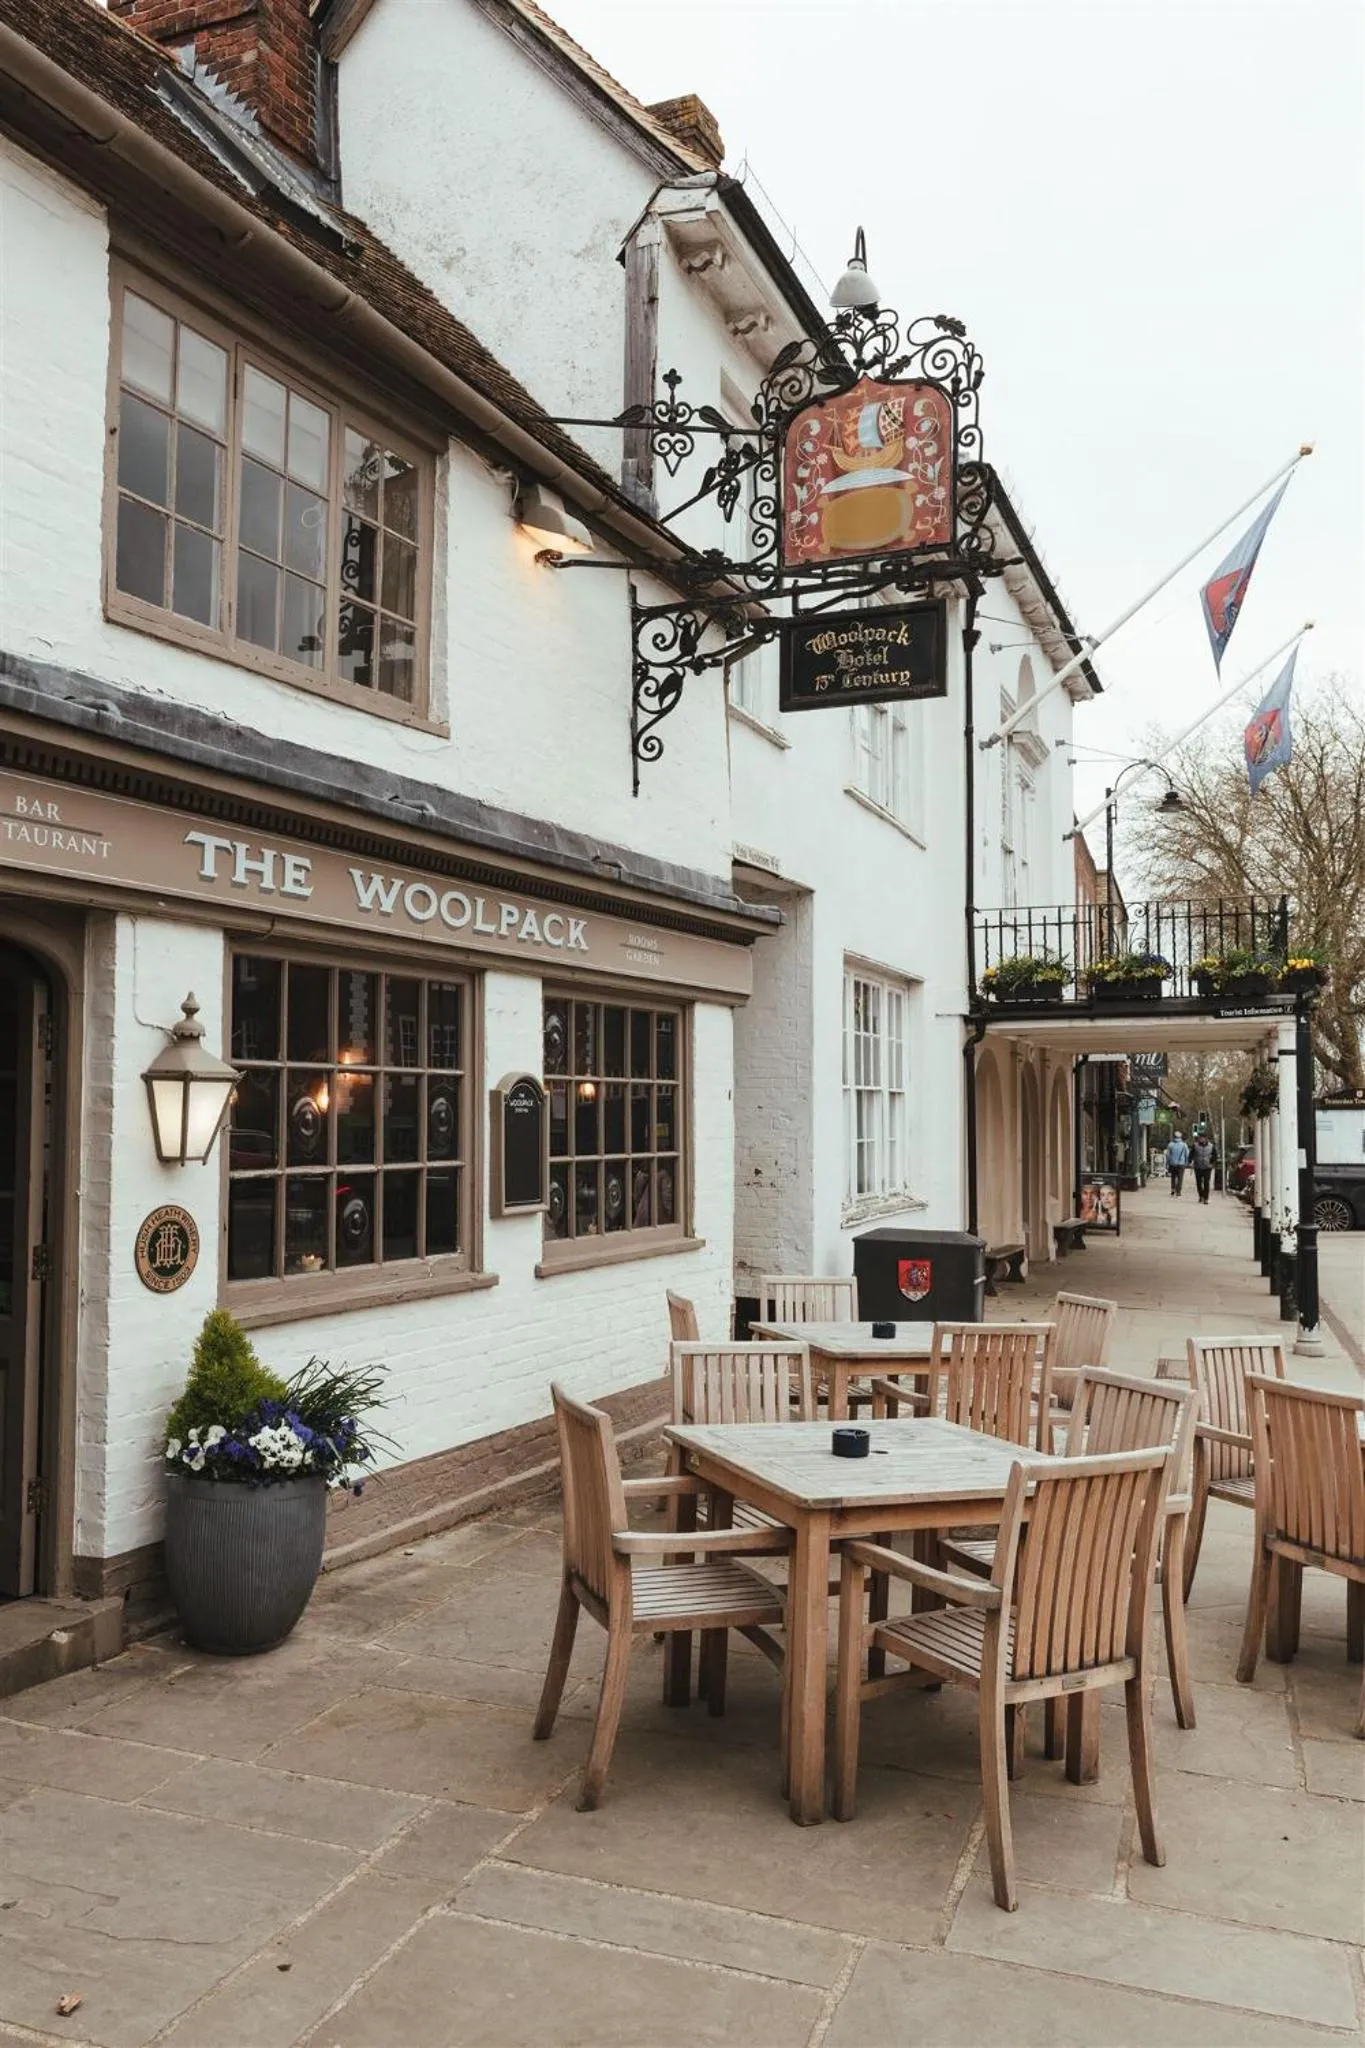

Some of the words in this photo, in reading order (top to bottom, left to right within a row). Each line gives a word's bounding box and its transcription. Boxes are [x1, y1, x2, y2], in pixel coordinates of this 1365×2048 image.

[805, 621, 912, 655] Woolpack
[834, 645, 889, 674] Hotel
[841, 669, 911, 688] Century
[16, 795, 62, 821] BAR
[184, 830, 314, 897] THE
[349, 867, 589, 950] WOOLPACK
[1220, 1008, 1242, 1017] Tourist
[1244, 1006, 1284, 1015] Information
[151, 1208, 181, 1224] HEATH
[144, 1271, 170, 1289] SINCE
